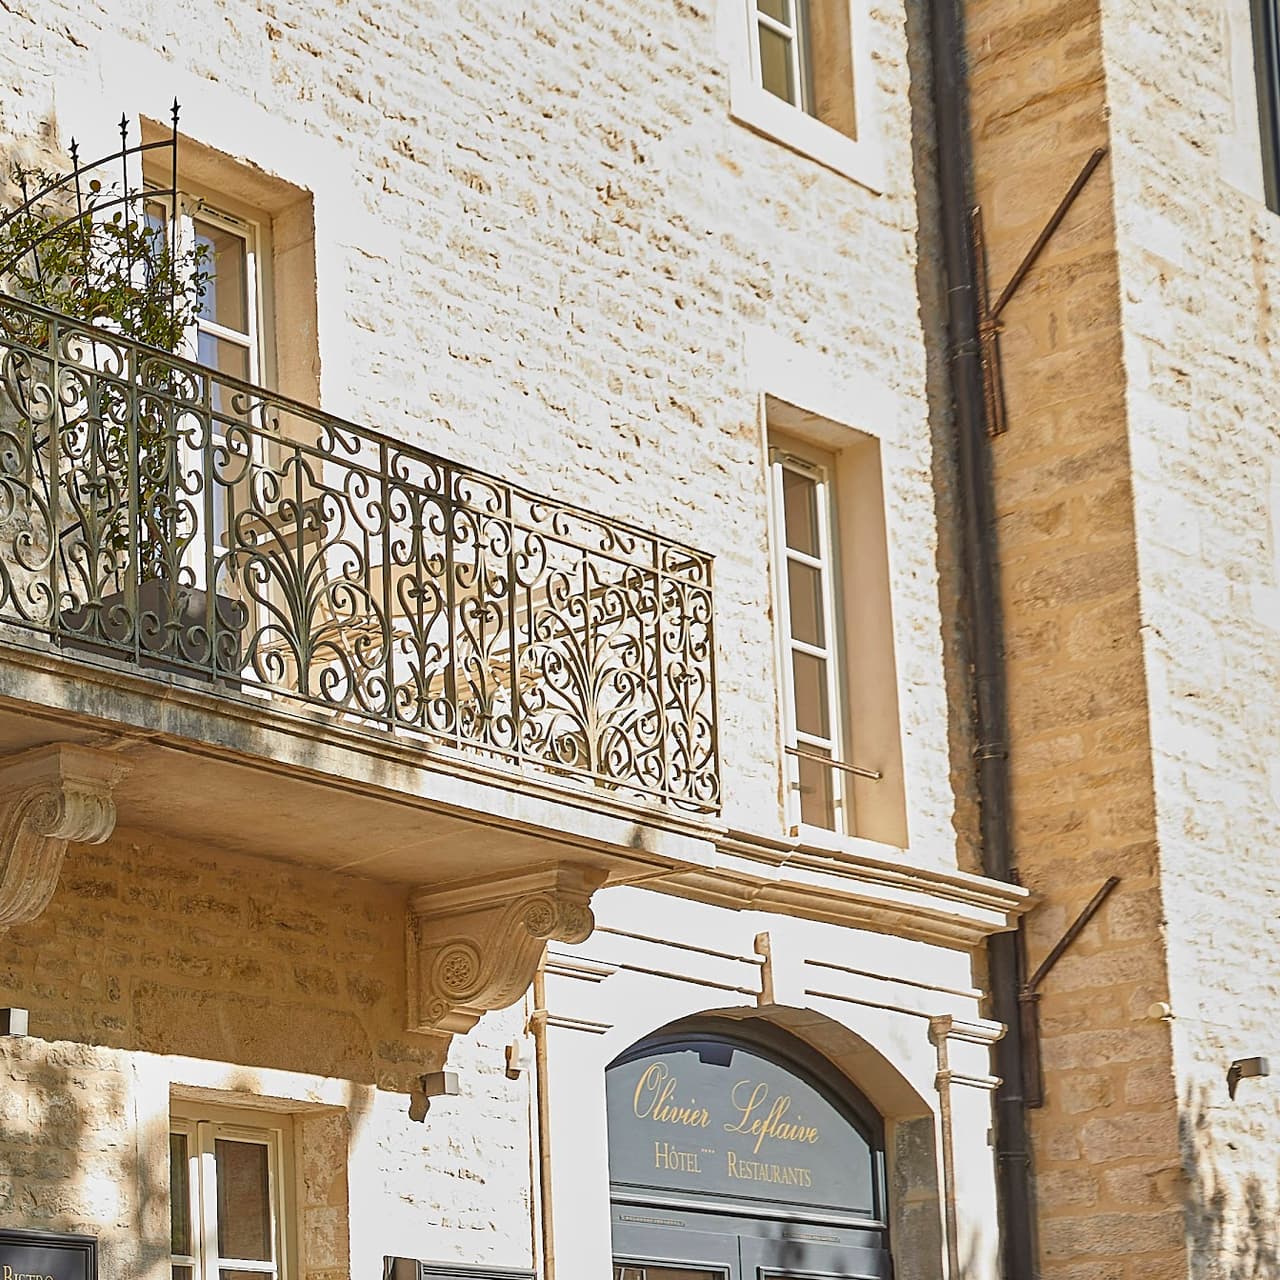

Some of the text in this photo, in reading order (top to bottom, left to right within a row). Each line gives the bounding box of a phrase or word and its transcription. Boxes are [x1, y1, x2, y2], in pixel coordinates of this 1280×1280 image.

[633, 1061, 820, 1154] Olivier Leflaive
[727, 1151, 812, 1187] RESTAURANTS
